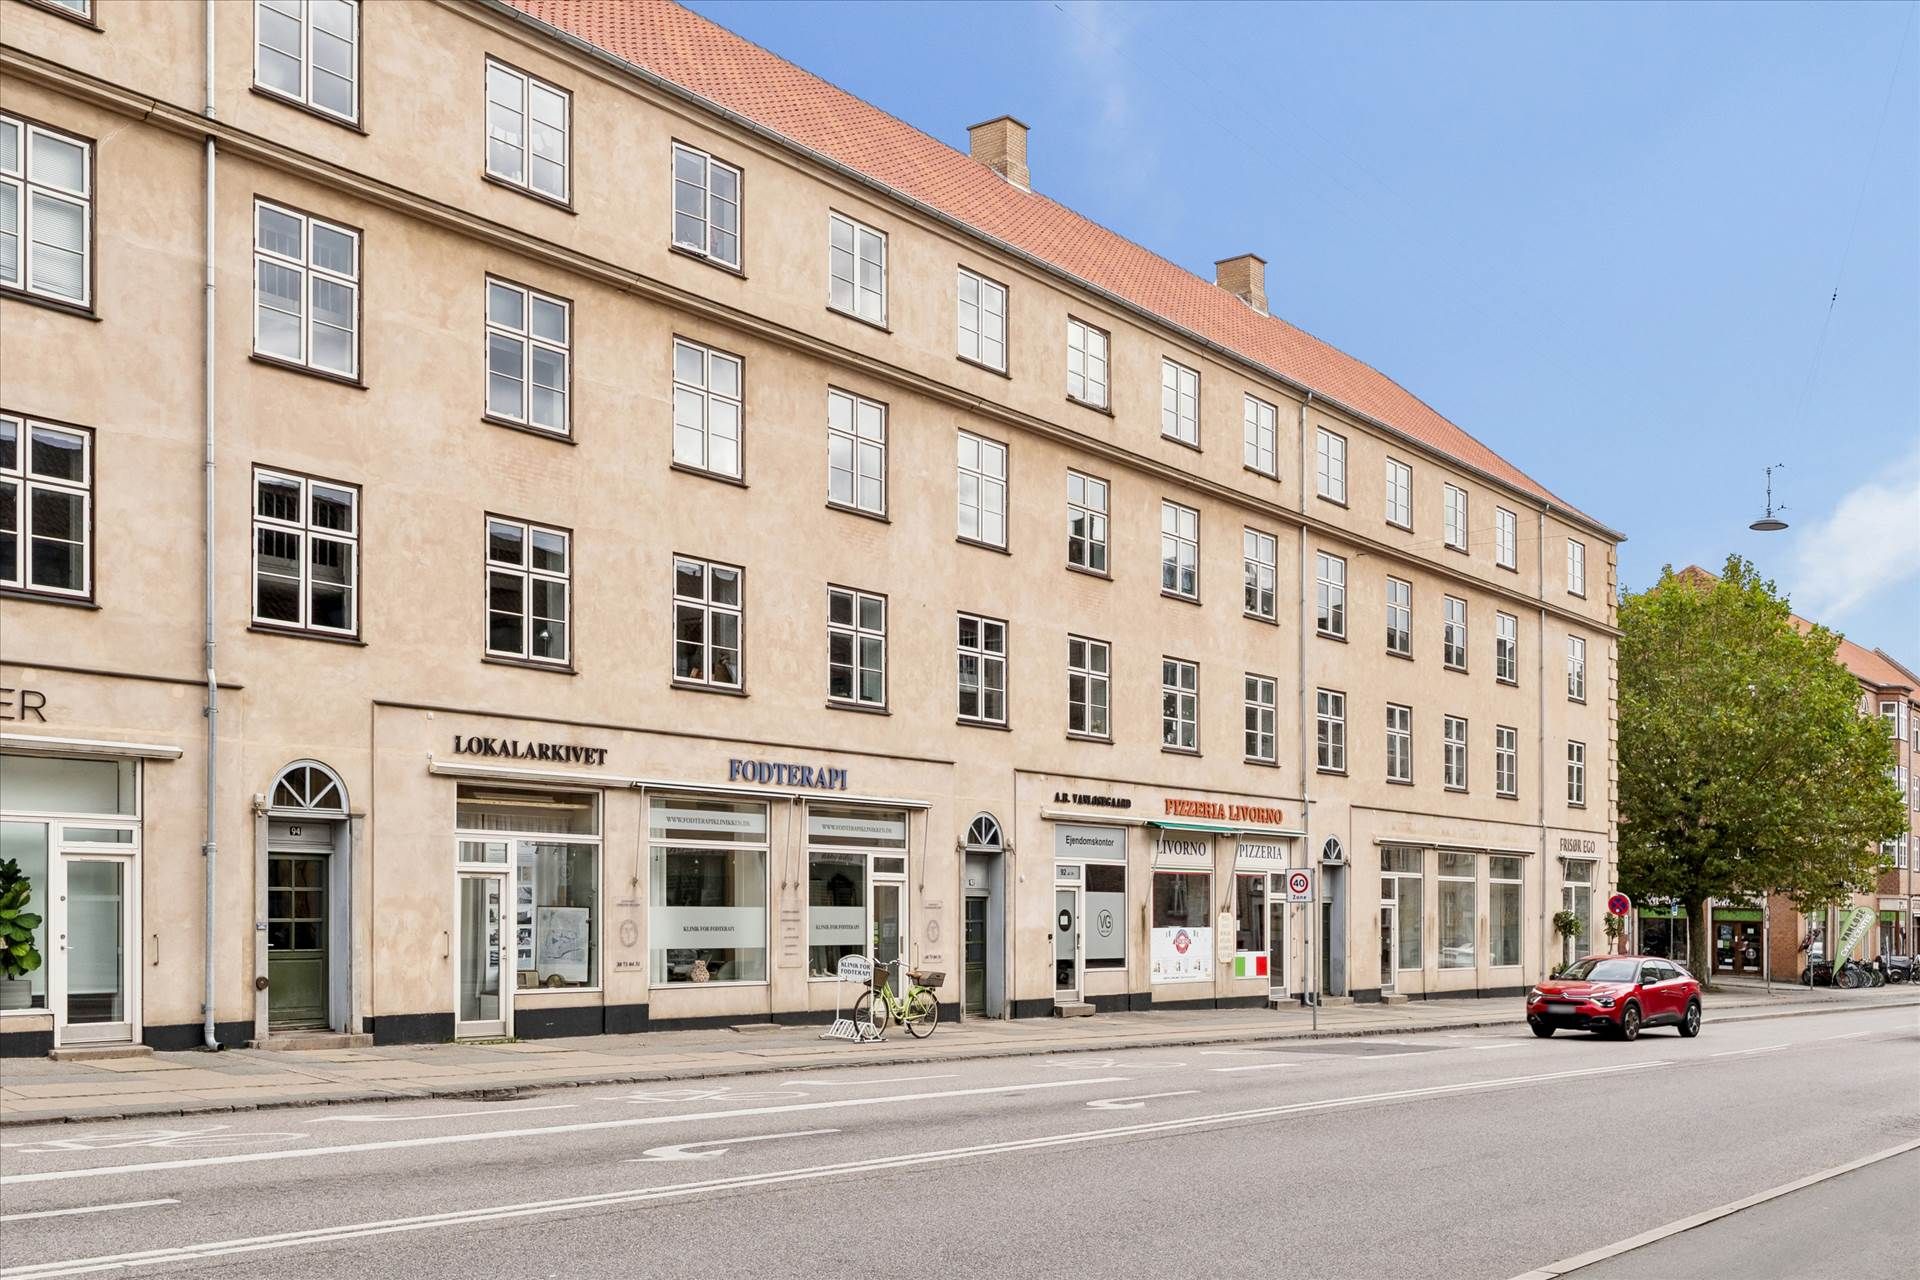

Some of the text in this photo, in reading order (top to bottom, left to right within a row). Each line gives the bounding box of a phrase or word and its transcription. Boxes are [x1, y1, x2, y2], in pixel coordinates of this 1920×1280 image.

[454, 735, 608, 766] LOKALARKIVET
[729, 758, 848, 791] FODTERAPI
[1165, 798, 1284, 825] PIZZERIA LIVORNO
[290, 826, 301, 836] 94
[1065, 835, 1114, 847] Ejendomskontor
[1156, 840, 1207, 857] LIVORNO
[1560, 838, 1596, 854] FRISØR EGO
[1239, 843, 1282, 860] PIZZERIA
[1293, 879, 1305, 888] 40
[1099, 914, 1112, 929] VG
[841, 969, 871, 977] FODTERAPI
